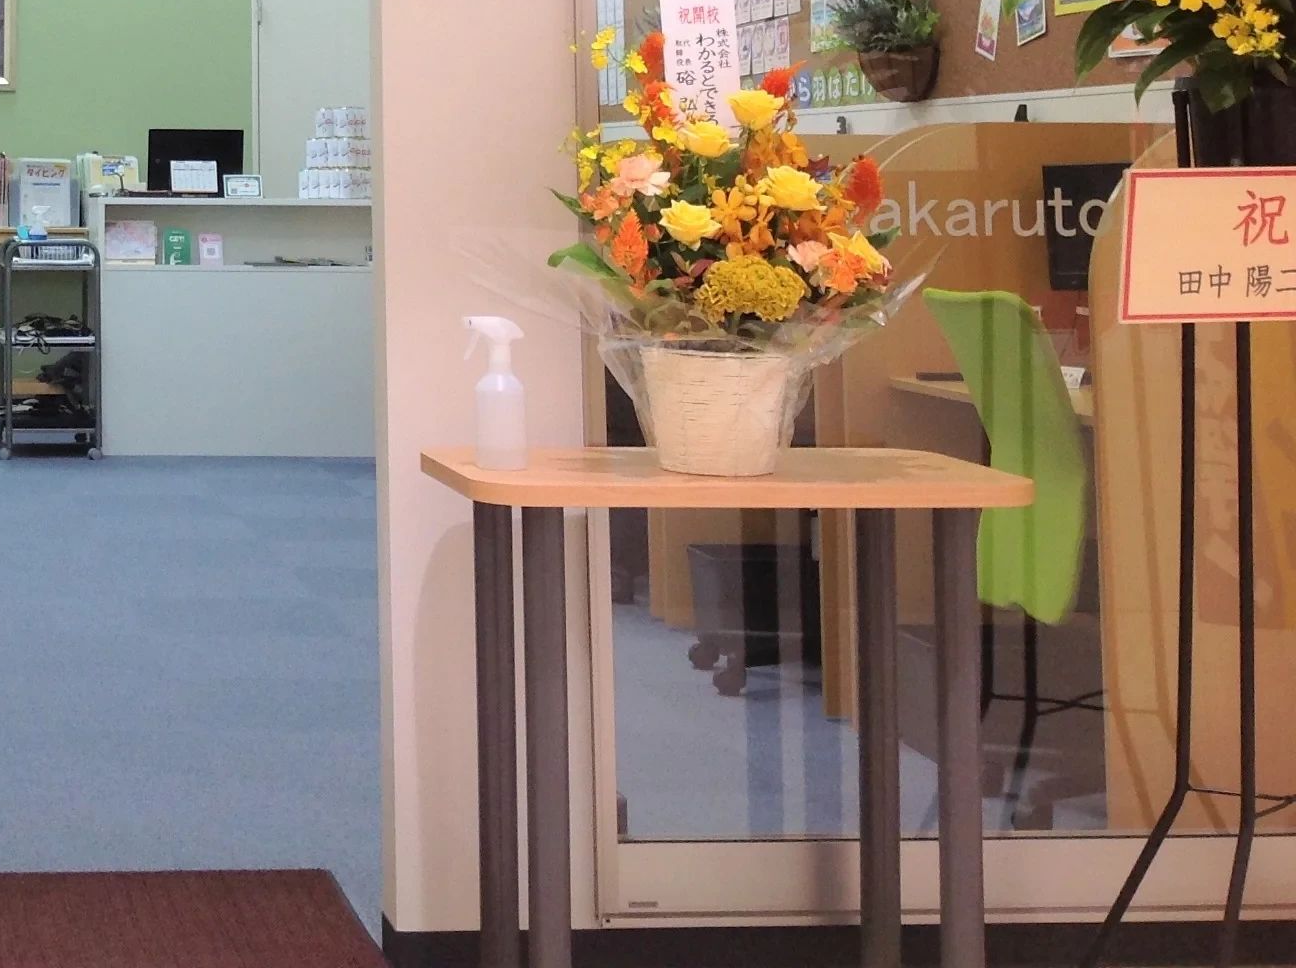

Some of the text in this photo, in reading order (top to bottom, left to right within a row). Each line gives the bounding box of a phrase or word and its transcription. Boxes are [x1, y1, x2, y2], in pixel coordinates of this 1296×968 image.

[678, 6, 721, 25] 祝開校
[716, 27, 732, 69] 株式会社
[27, 169, 65, 179] タイピング
[850, 180, 1109, 237] akaruto
[1233, 189, 1289, 247] 祝
[1179, 264, 1232, 298] 田中
